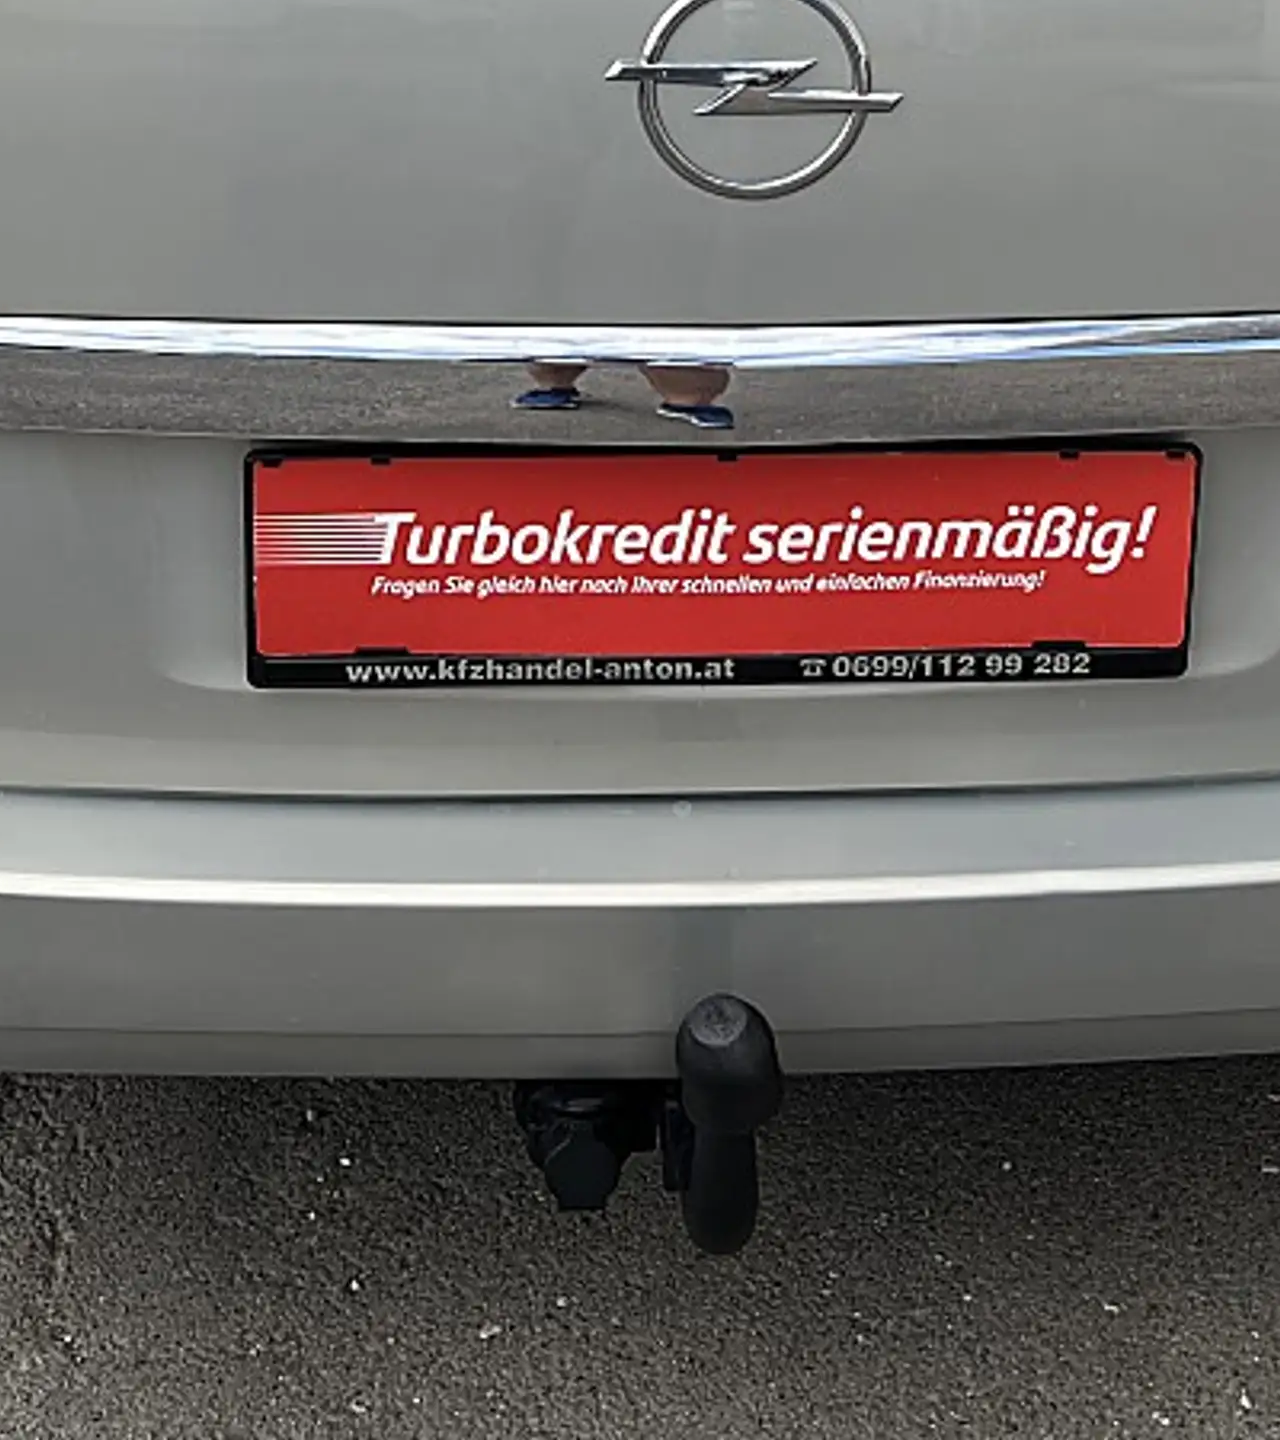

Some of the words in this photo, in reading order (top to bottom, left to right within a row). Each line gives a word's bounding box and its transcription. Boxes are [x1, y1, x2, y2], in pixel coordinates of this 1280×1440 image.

[373, 508, 737, 566] Turbokredit
[742, 504, 1157, 575] serienmäßig!
[371, 575, 440, 601] Fragen
[444, 574, 474, 594] Sie
[476, 573, 536, 601] gleich
[539, 574, 579, 594] hier
[630, 574, 678, 594] Ihrer
[681, 573, 772, 594] schnellen
[774, 572, 815, 594] und
[815, 570, 911, 592] einfachen
[913, 568, 1047, 594] Finanzierung!
[345, 657, 736, 683] www.kfzhandel-anton.at
[831, 653, 977, 680] 0699/112
[985, 653, 1023, 675] 99
[1033, 652, 1091, 674] 282
